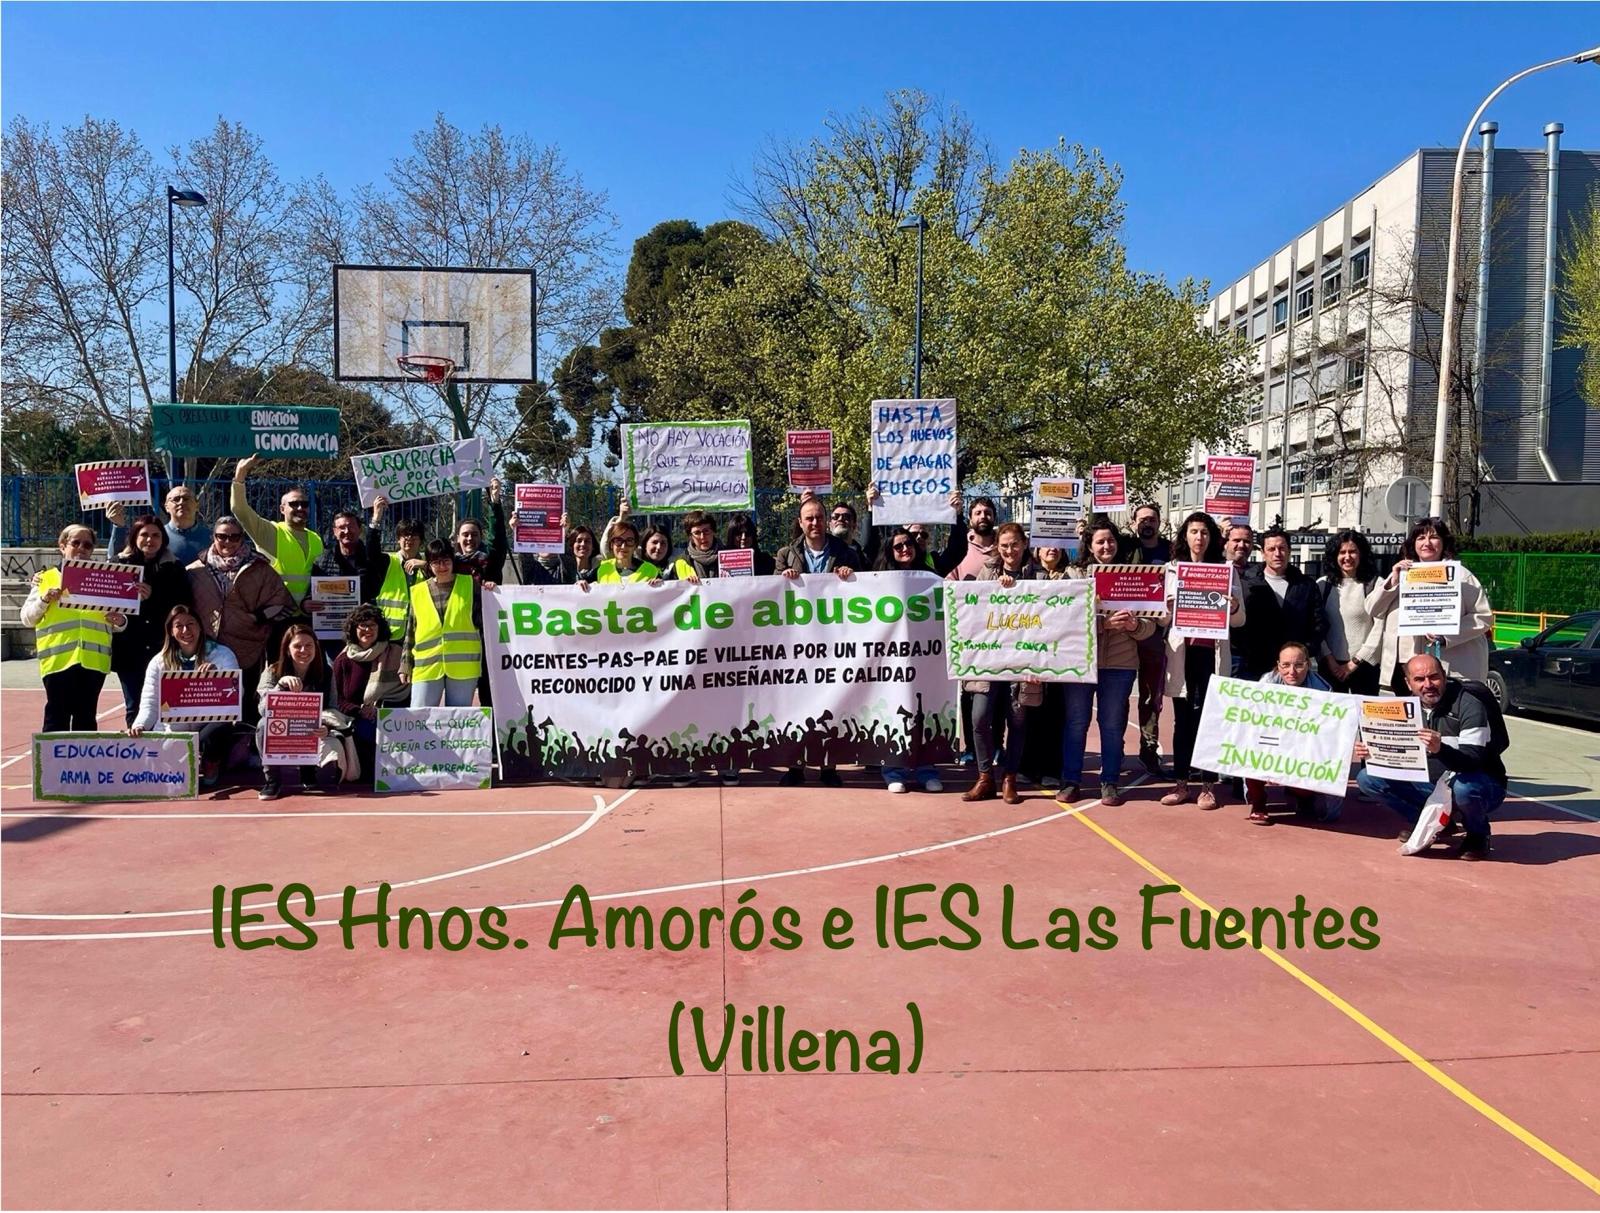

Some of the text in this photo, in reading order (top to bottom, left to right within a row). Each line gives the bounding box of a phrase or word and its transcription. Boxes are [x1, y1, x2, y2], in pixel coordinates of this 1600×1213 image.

[251, 410, 299, 426] EDUCACIÓN
[879, 406, 942, 424] HASTA
[254, 432, 339, 452] IGNORANCIA
[639, 429, 750, 448] NO HAY VOCACIÓN
[790, 435, 796, 444] 7
[878, 427, 953, 444] LOS HUEVOS
[360, 445, 456, 478] BUROCRACIA
[656, 454, 738, 469] QUE AGUANTE
[877, 453, 952, 471] DE APAGAR
[1210, 461, 1217, 470] 7
[407, 470, 438, 481] POCA
[388, 475, 460, 500] GRACIA!
[519, 488, 526, 498] 7
[644, 479, 749, 494] ESTA SITUACIÓN
[878, 477, 951, 496] FUEGOS
[1367, 533, 1405, 544] morós
[1181, 567, 1188, 577] 7
[965, 593, 1076, 608] UN DOCENTE QUE
[498, 587, 944, 644] ¡Basta de abusos!
[987, 612, 1042, 630] LUCHA
[502, 639, 942, 671] DOCENTES-PAS-PAE DE VILLENA POR UN TRABAJO
[531, 666, 917, 694] RECONOCIDO Y UNA ENSEÑANZA DE CALIDAD
[270, 696, 279, 706] 7
[1218, 681, 1312, 710] RECORTES
[1321, 702, 1348, 720] EN
[383, 718, 481, 732] CUIDAR A QUIEN
[1224, 706, 1320, 735] EDUCACIÓN
[54, 743, 146, 761] EDUCACIÓN
[381, 739, 491, 753] ENSEÑA ES PROTEGER
[381, 768, 389, 776] A
[432, 763, 479, 773] APRENDE
[1217, 743, 1342, 783] INVOLUCIÓN
[60, 770, 90, 784] ARMA
[98, 772, 114, 784] DE
